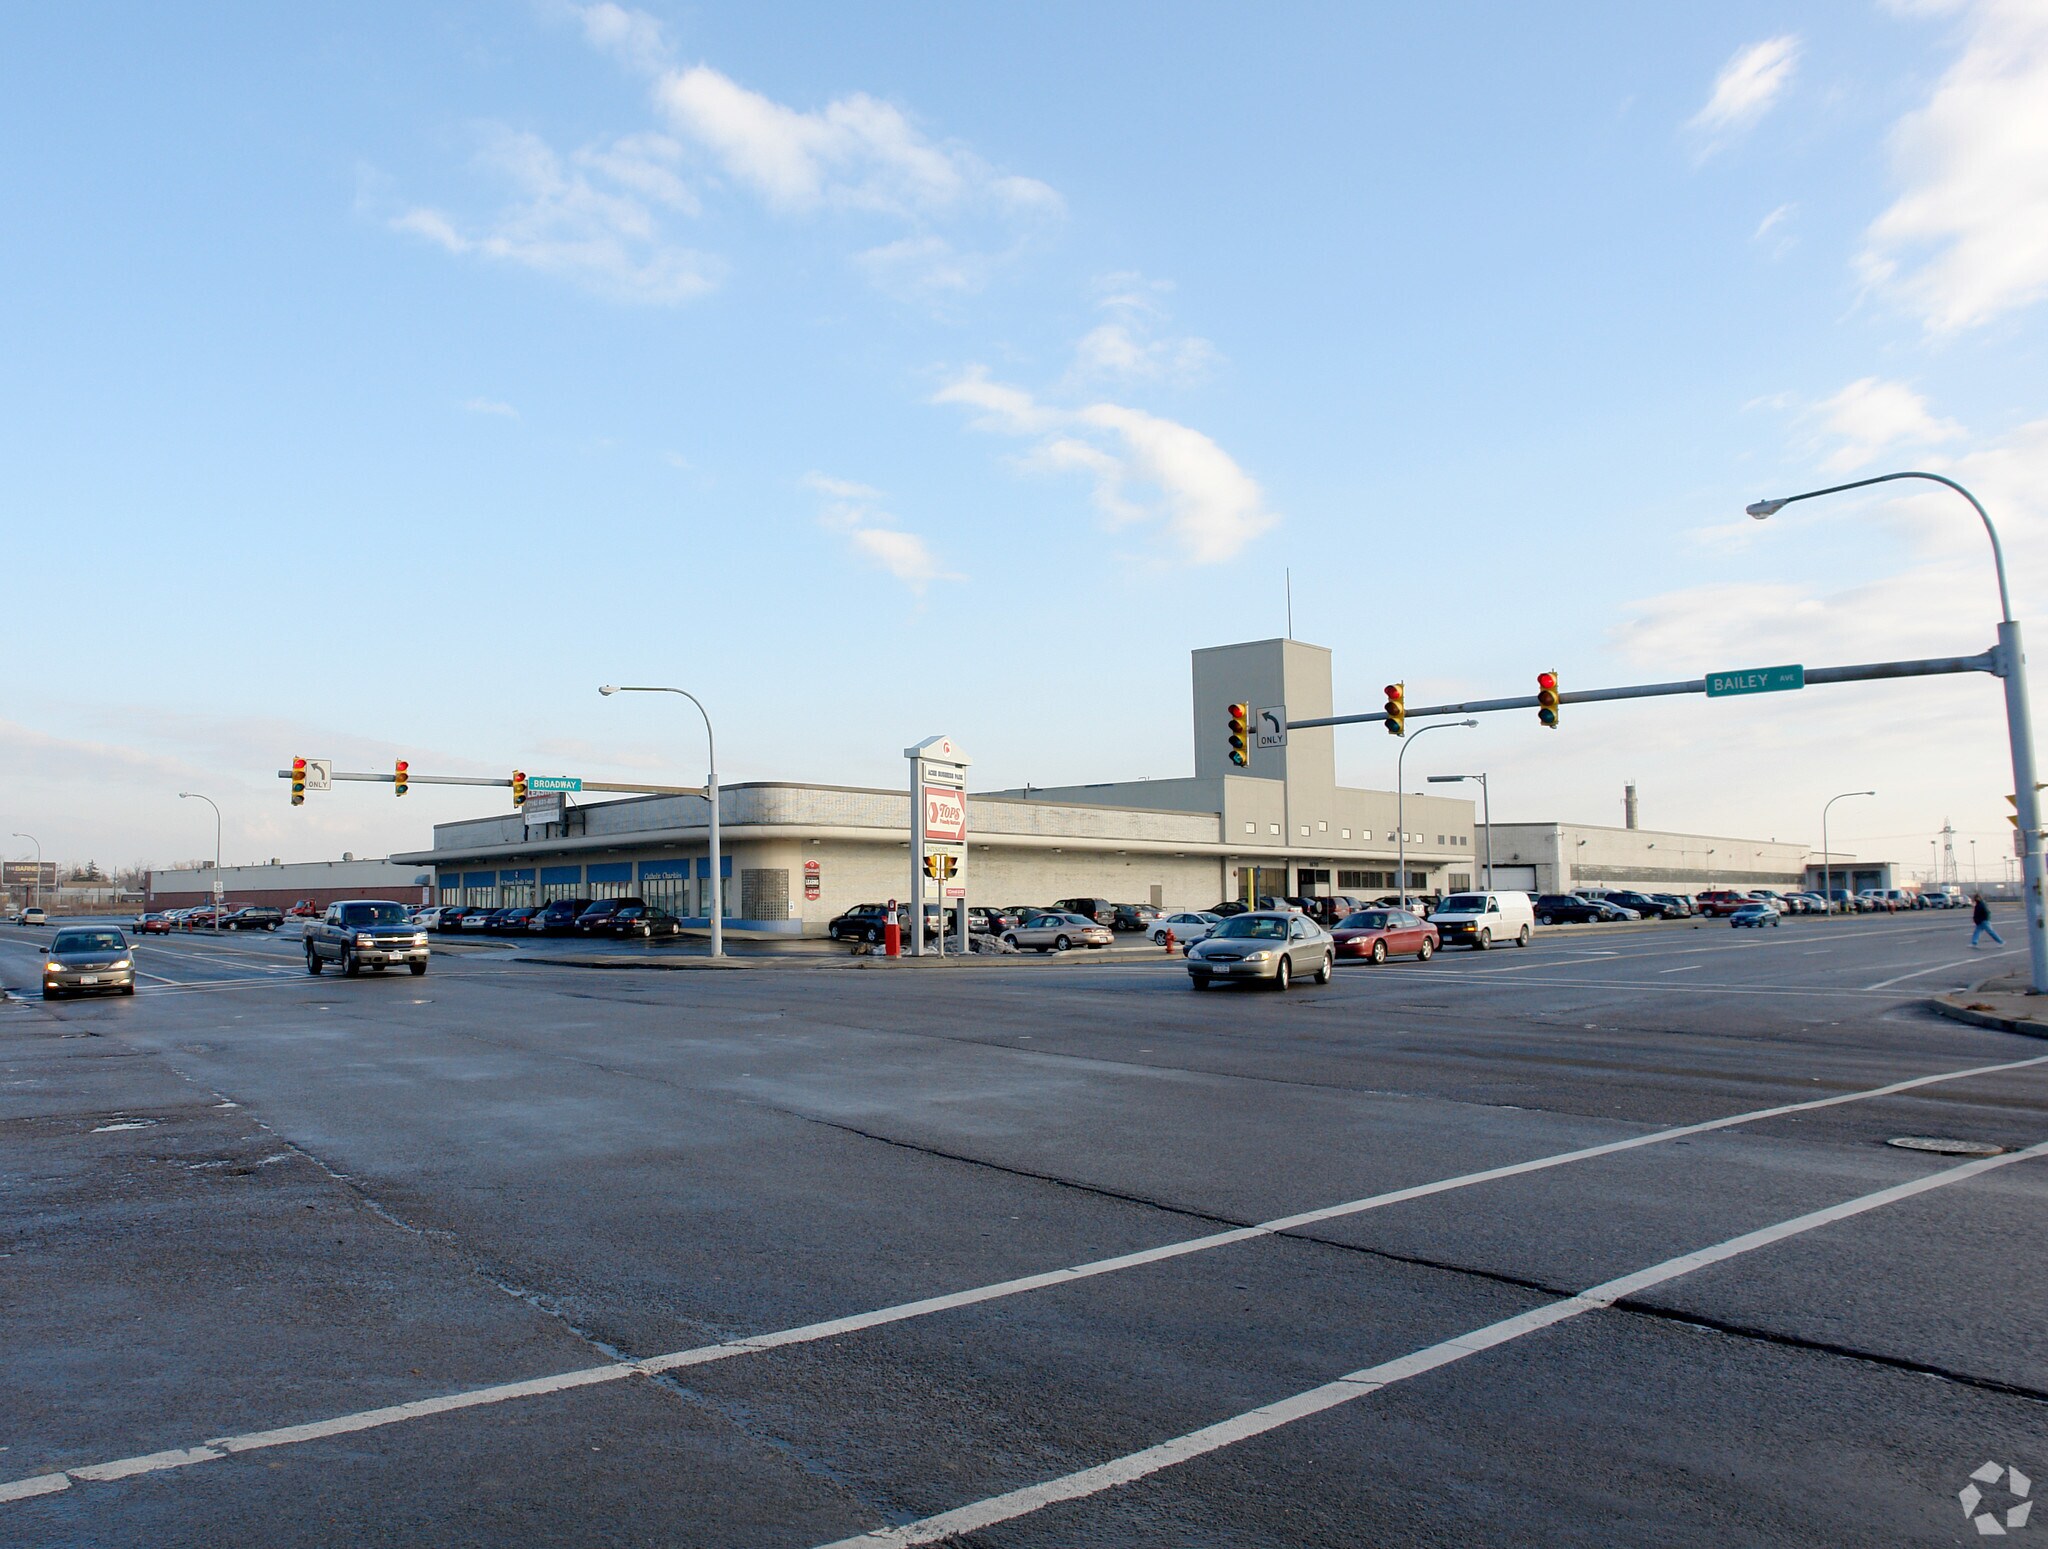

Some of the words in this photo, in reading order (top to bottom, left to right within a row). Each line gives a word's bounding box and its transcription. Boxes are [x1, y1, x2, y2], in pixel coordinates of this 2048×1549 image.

[1714, 674, 1768, 691] BAILEY
[1780, 674, 1795, 682] AVE
[1261, 735, 1283, 745] ONLY
[533, 779, 577, 789] BROADWAY
